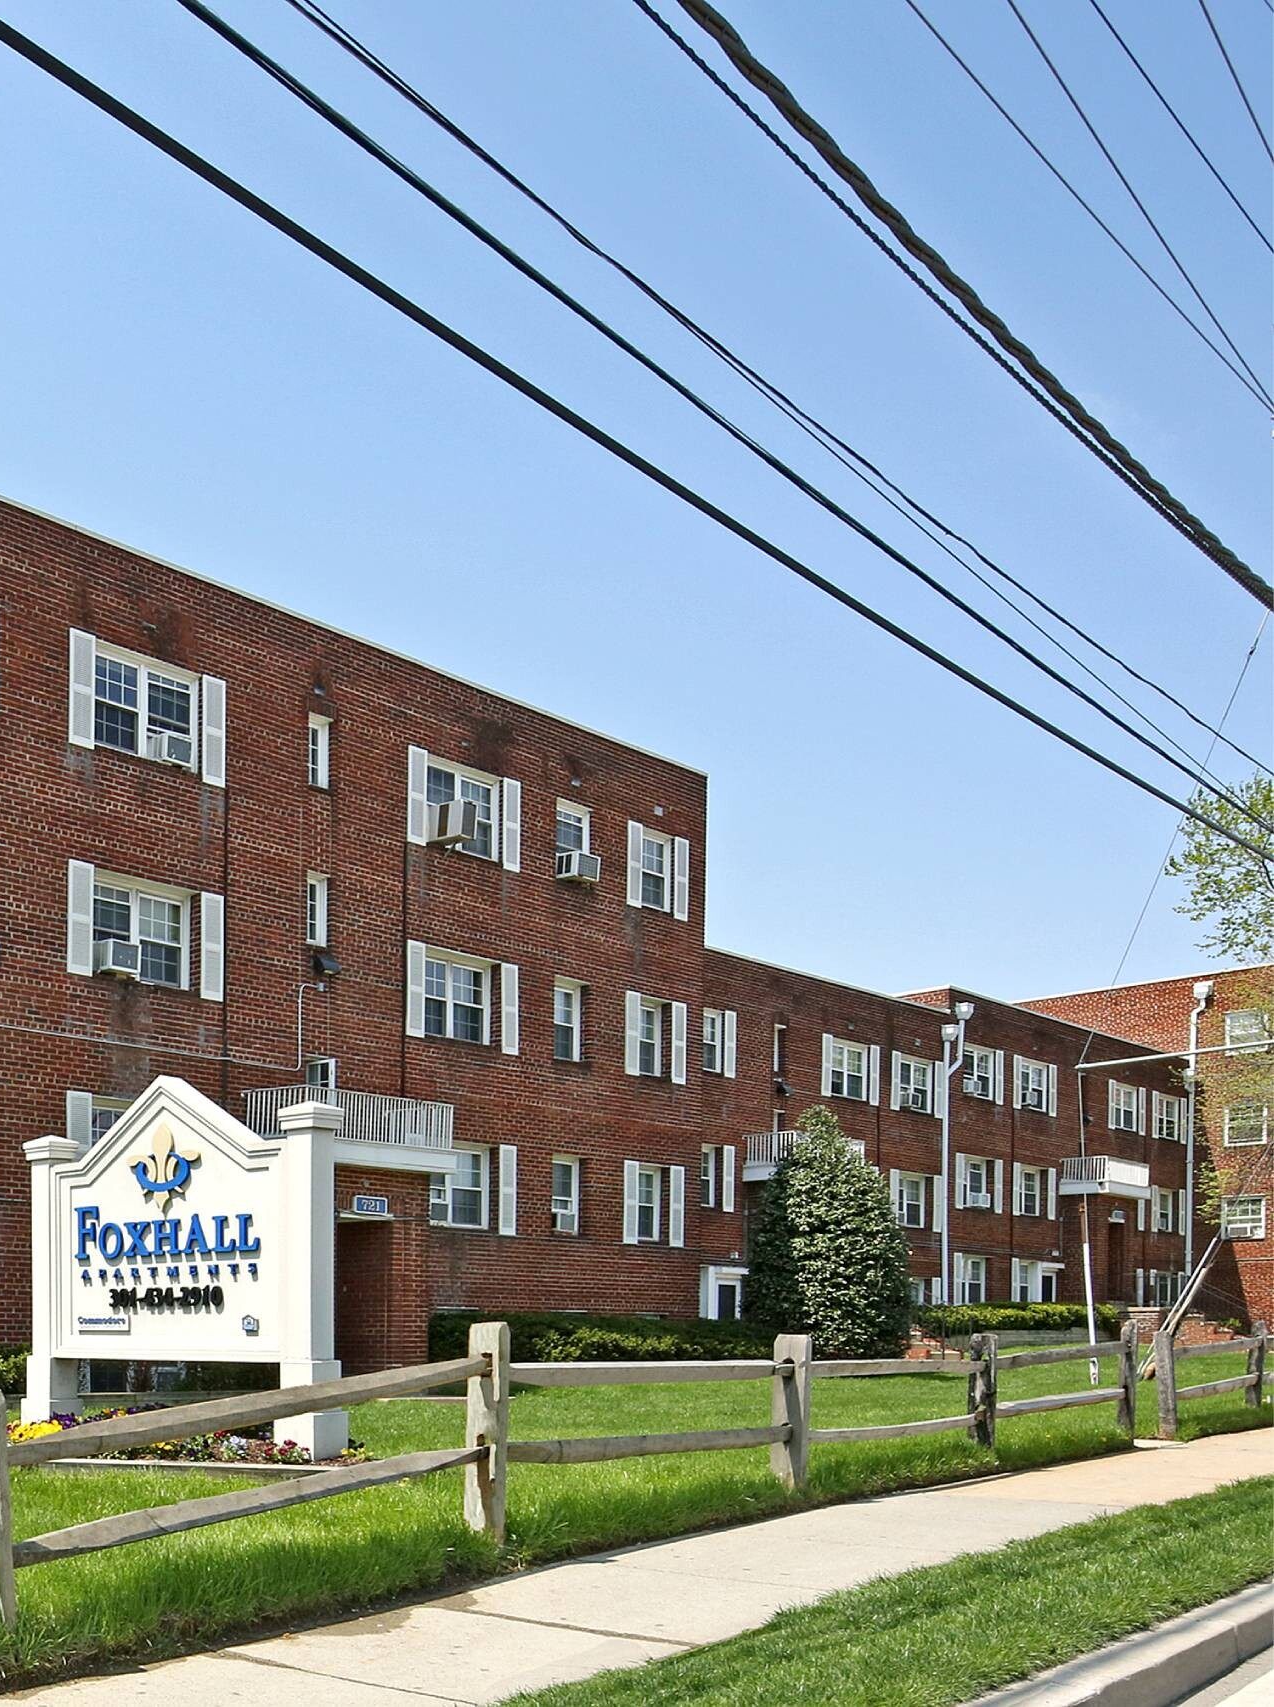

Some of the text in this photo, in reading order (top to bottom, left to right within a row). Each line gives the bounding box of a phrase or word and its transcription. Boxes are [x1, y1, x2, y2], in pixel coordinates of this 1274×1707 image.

[361, 1199, 380, 1212] 721
[74, 1205, 261, 1260] FOXHALL
[81, 1263, 258, 1283] APARTMENTS
[109, 1285, 224, 1307] 301-434-2910
